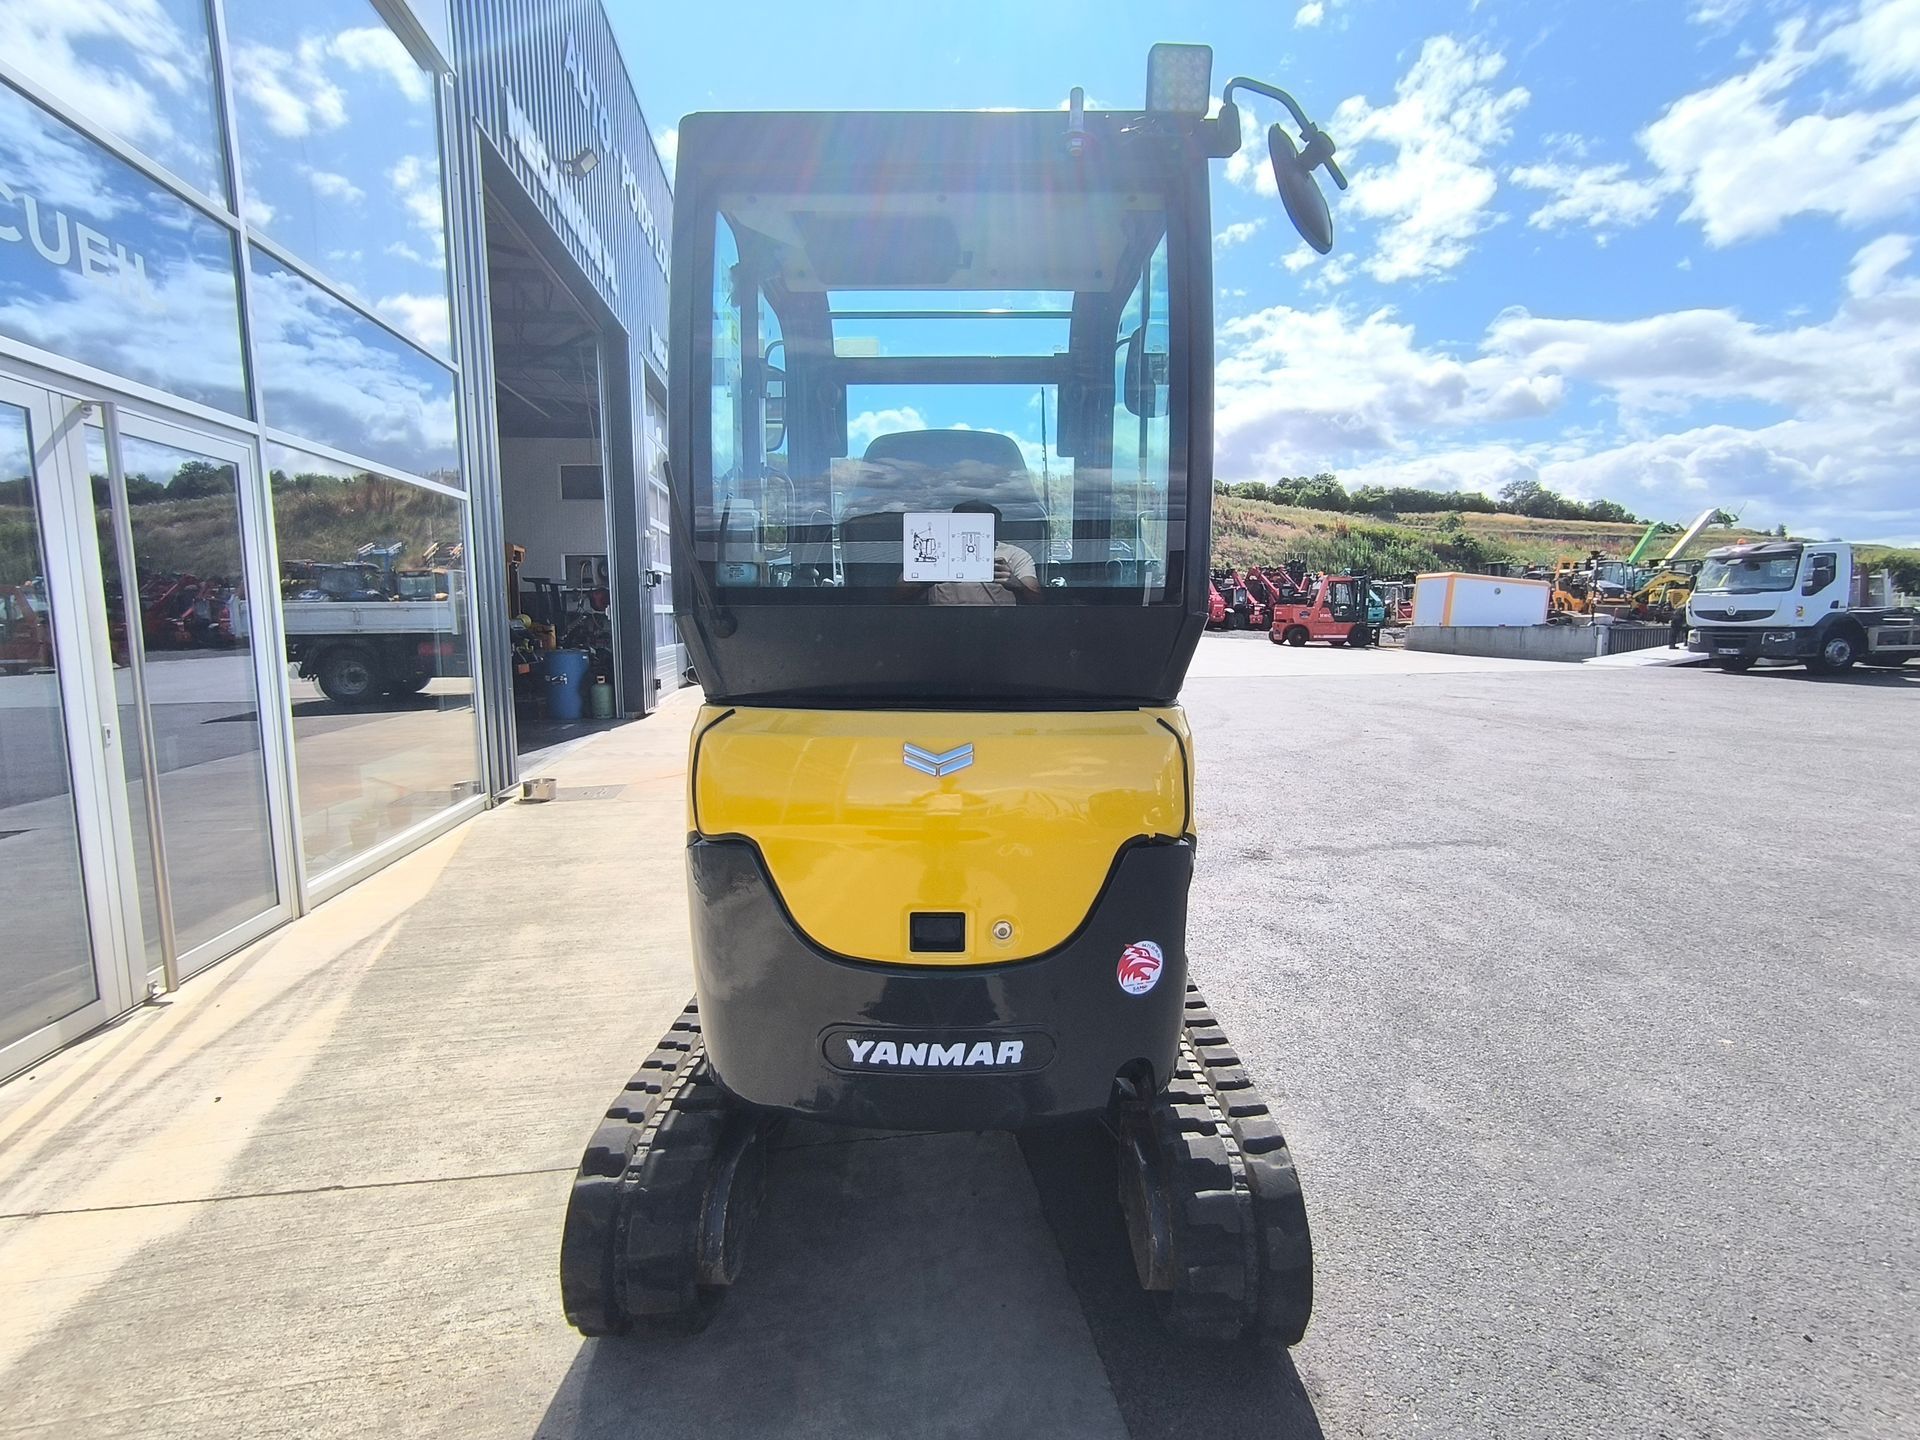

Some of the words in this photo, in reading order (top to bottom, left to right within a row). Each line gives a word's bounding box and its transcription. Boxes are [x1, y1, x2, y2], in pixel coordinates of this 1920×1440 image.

[564, 32, 612, 153] AUTO
[622, 152, 654, 248] POIDS
[846, 1039, 1024, 1066] YANMAR
